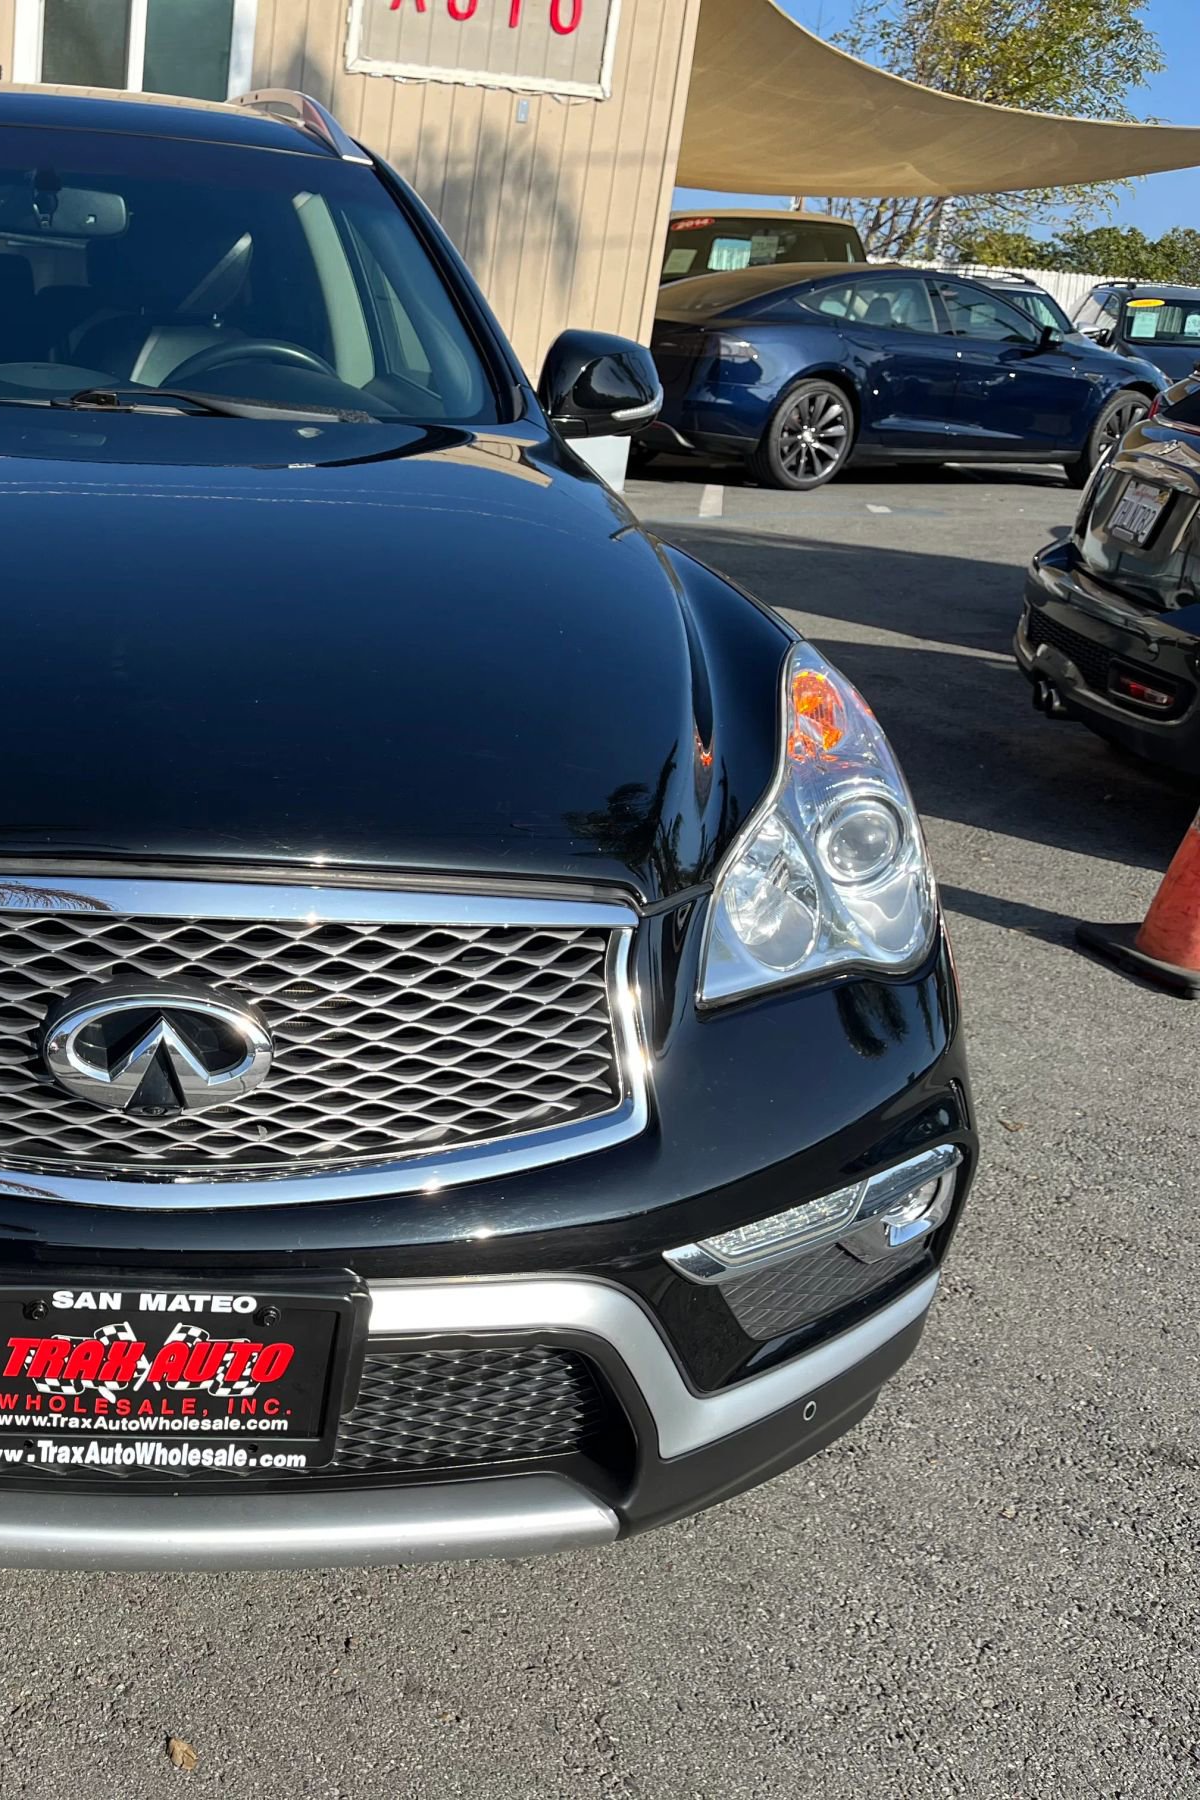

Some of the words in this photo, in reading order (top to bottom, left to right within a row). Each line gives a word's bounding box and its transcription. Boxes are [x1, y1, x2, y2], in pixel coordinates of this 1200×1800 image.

[52, 1290, 122, 1311] SAN
[139, 1293, 258, 1314] MATEO
[2, 1337, 146, 1383] TRAX
[147, 1341, 295, 1384] AUTO
[227, 1397, 292, 1415] INC.
